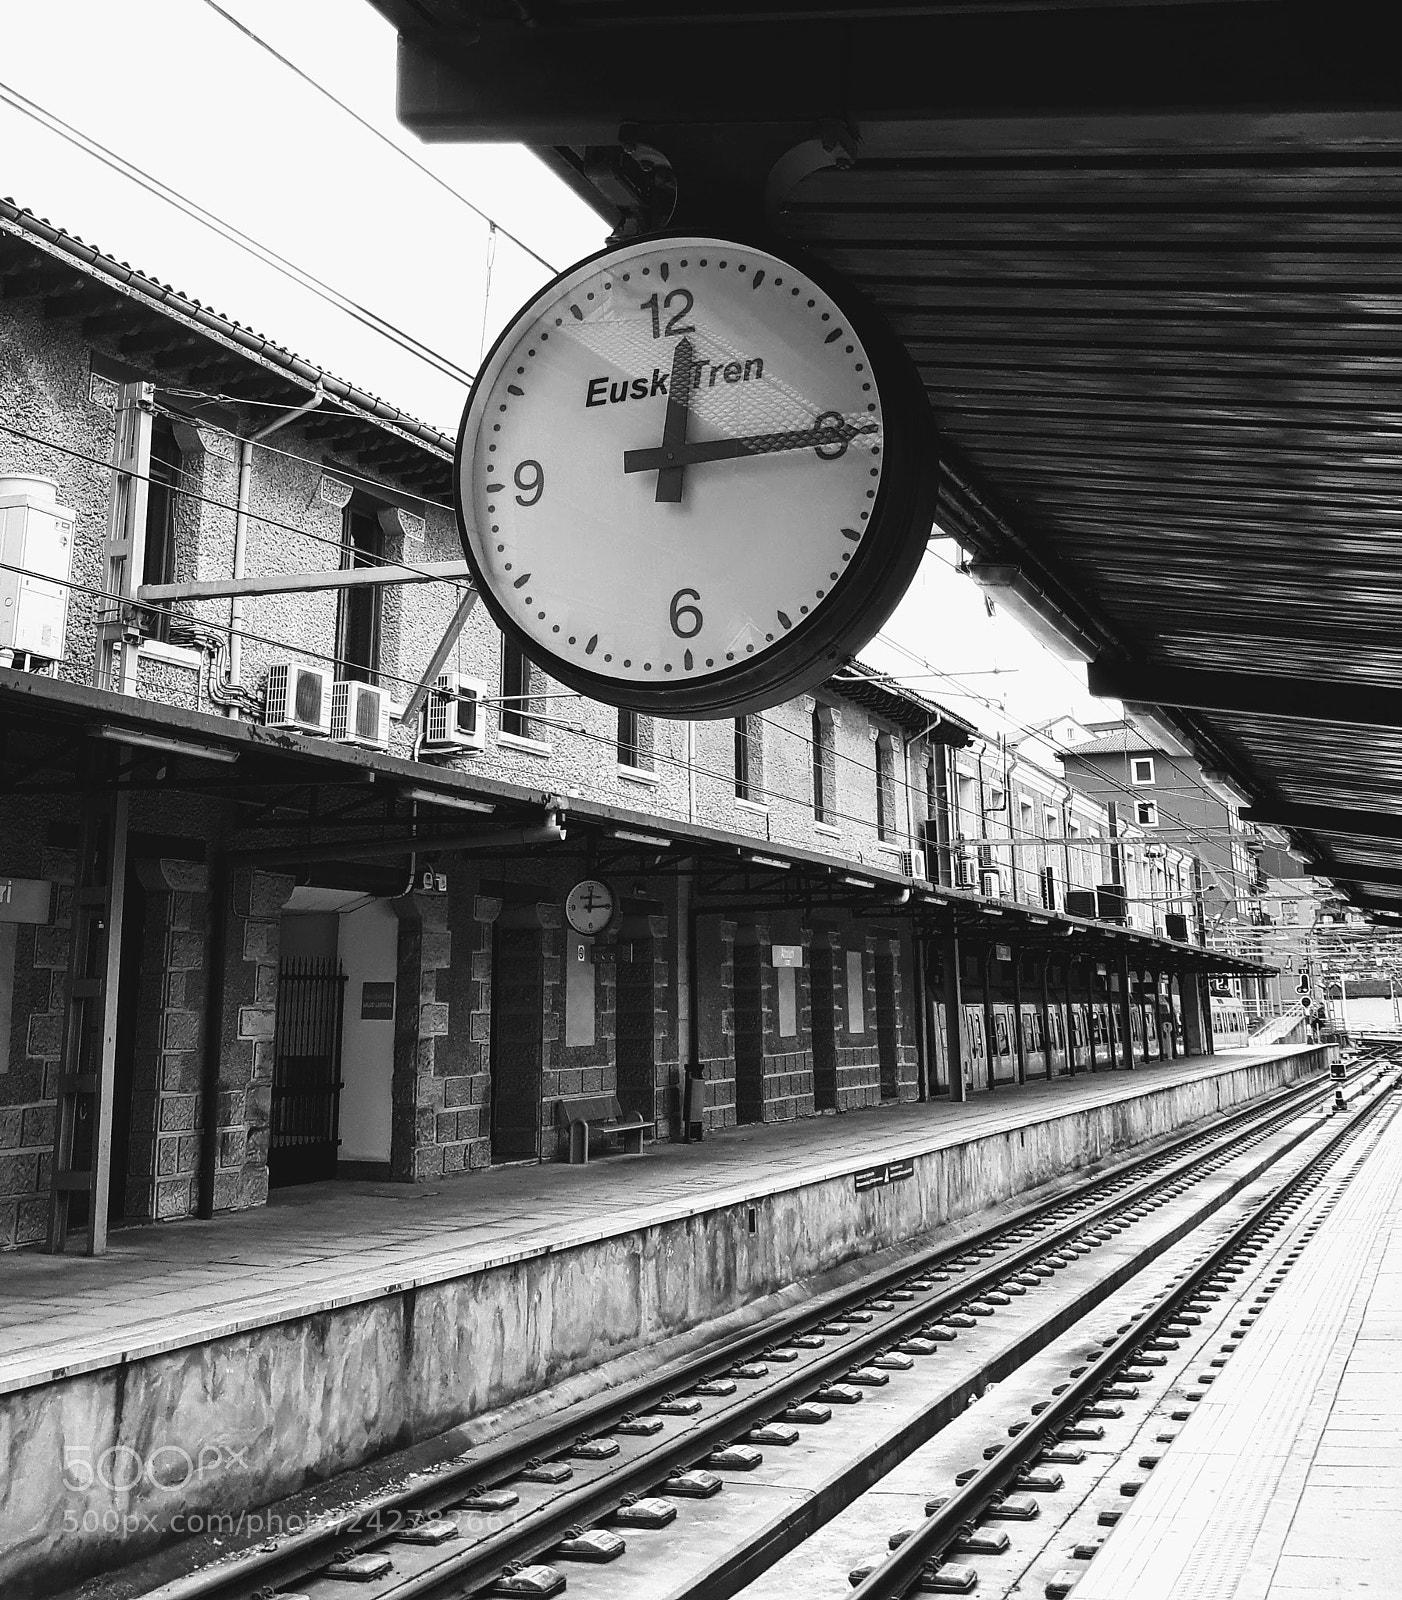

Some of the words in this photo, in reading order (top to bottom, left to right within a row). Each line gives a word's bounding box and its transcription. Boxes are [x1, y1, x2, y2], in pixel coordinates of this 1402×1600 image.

[640, 288, 695, 339] 12
[814, 411, 848, 460] 3
[514, 460, 544, 507] 9
[670, 588, 703, 638] 6
